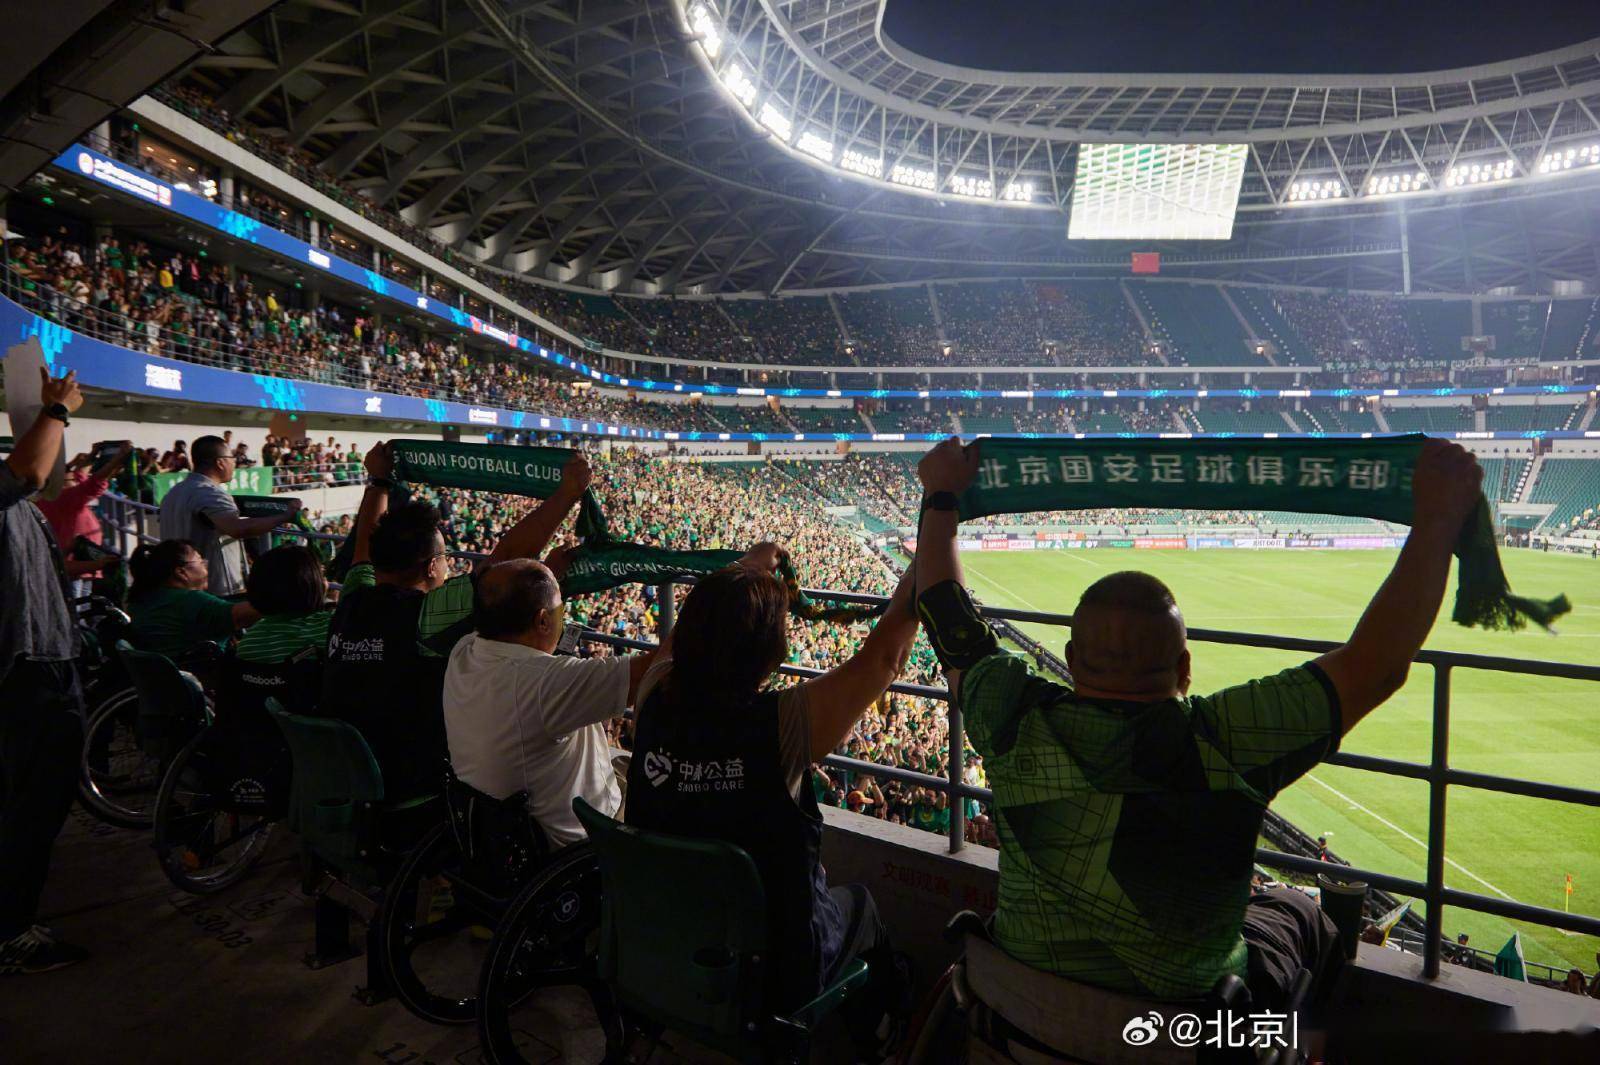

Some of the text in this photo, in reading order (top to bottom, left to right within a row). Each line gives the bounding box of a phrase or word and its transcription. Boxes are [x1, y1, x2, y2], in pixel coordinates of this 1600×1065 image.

[450, 454, 521, 476] FOOTBALL
[524, 463, 562, 482] CLUB
[977, 453, 1391, 491] 北京国安足球俱乐部
[713, 779, 745, 791] CARE
